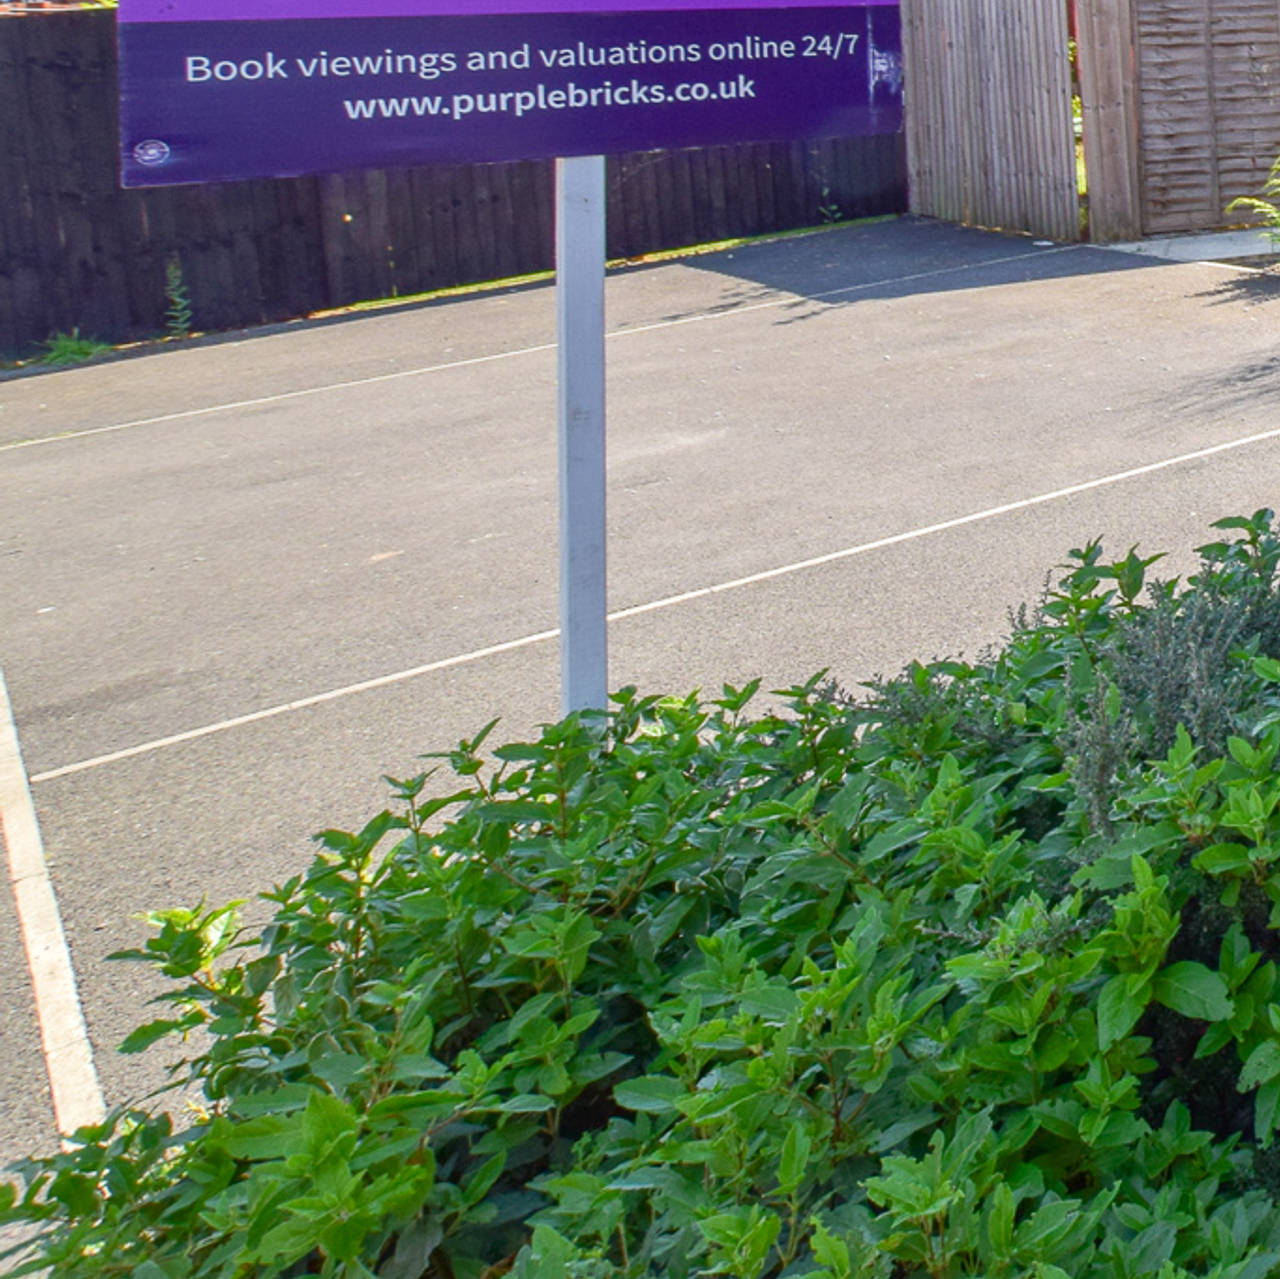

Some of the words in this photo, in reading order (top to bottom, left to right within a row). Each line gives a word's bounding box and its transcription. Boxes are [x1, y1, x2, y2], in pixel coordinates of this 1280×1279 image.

[186, 51, 289, 83] Book
[296, 48, 458, 80] viewings
[467, 43, 531, 71] and
[538, 39, 701, 68] valuations
[708, 35, 796, 61] online
[801, 32, 860, 60] 24/7
[343, 74, 757, 120] www.purplebricks.co.uk
